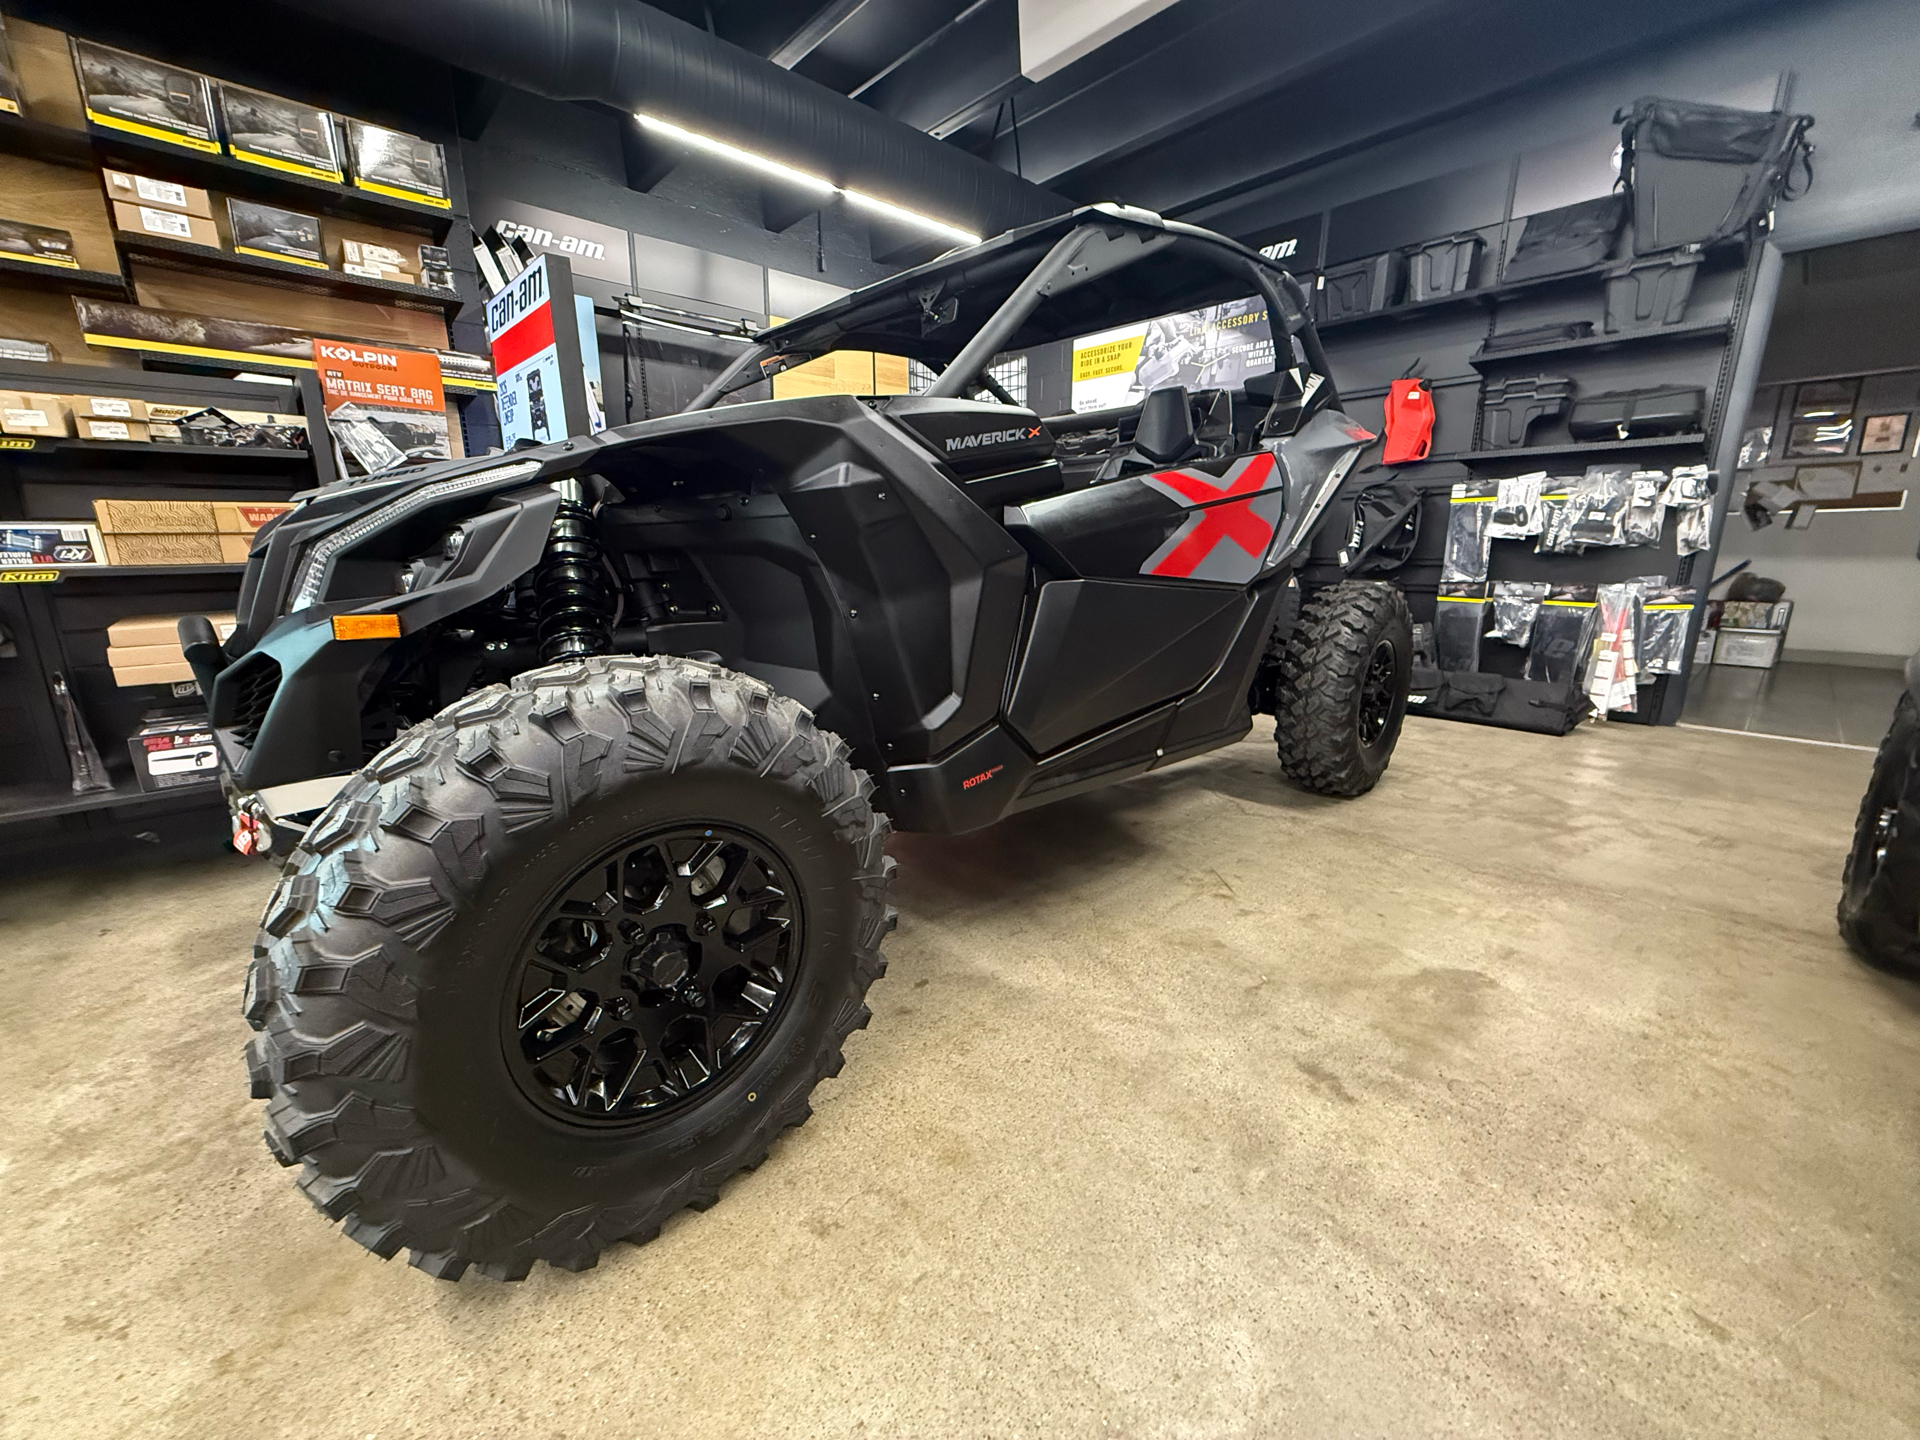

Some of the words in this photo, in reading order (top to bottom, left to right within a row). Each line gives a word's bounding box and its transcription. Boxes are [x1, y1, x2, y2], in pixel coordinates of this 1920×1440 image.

[496, 220, 603, 260] can-am
[491, 265, 543, 333] can-am
[320, 346, 397, 366] KOLPIN
[1080, 345, 1116, 359] ACCESSORIZE
[1117, 341, 1133, 351] YOUR
[1231, 343, 1254, 354] SECURE
[1255, 340, 1267, 350] AND
[1248, 349, 1264, 359] WITH
[352, 361, 398, 372] OUTDOORS
[1080, 358, 1093, 367] RIDE
[1094, 357, 1100, 365] IN
[1106, 352, 1121, 362] SNAP
[325, 377, 372, 393] MATRIX
[376, 383, 406, 397] SEAT
[410, 388, 433, 400] BAG
[945, 427, 1026, 451] MAVERICK
[346, 467, 427, 486] TURBO
[1546, 510, 1562, 546] can-am
[59, 547, 87, 561] KFI
[3, 572, 55, 581] Klim
[962, 769, 993, 790] ROTAX
